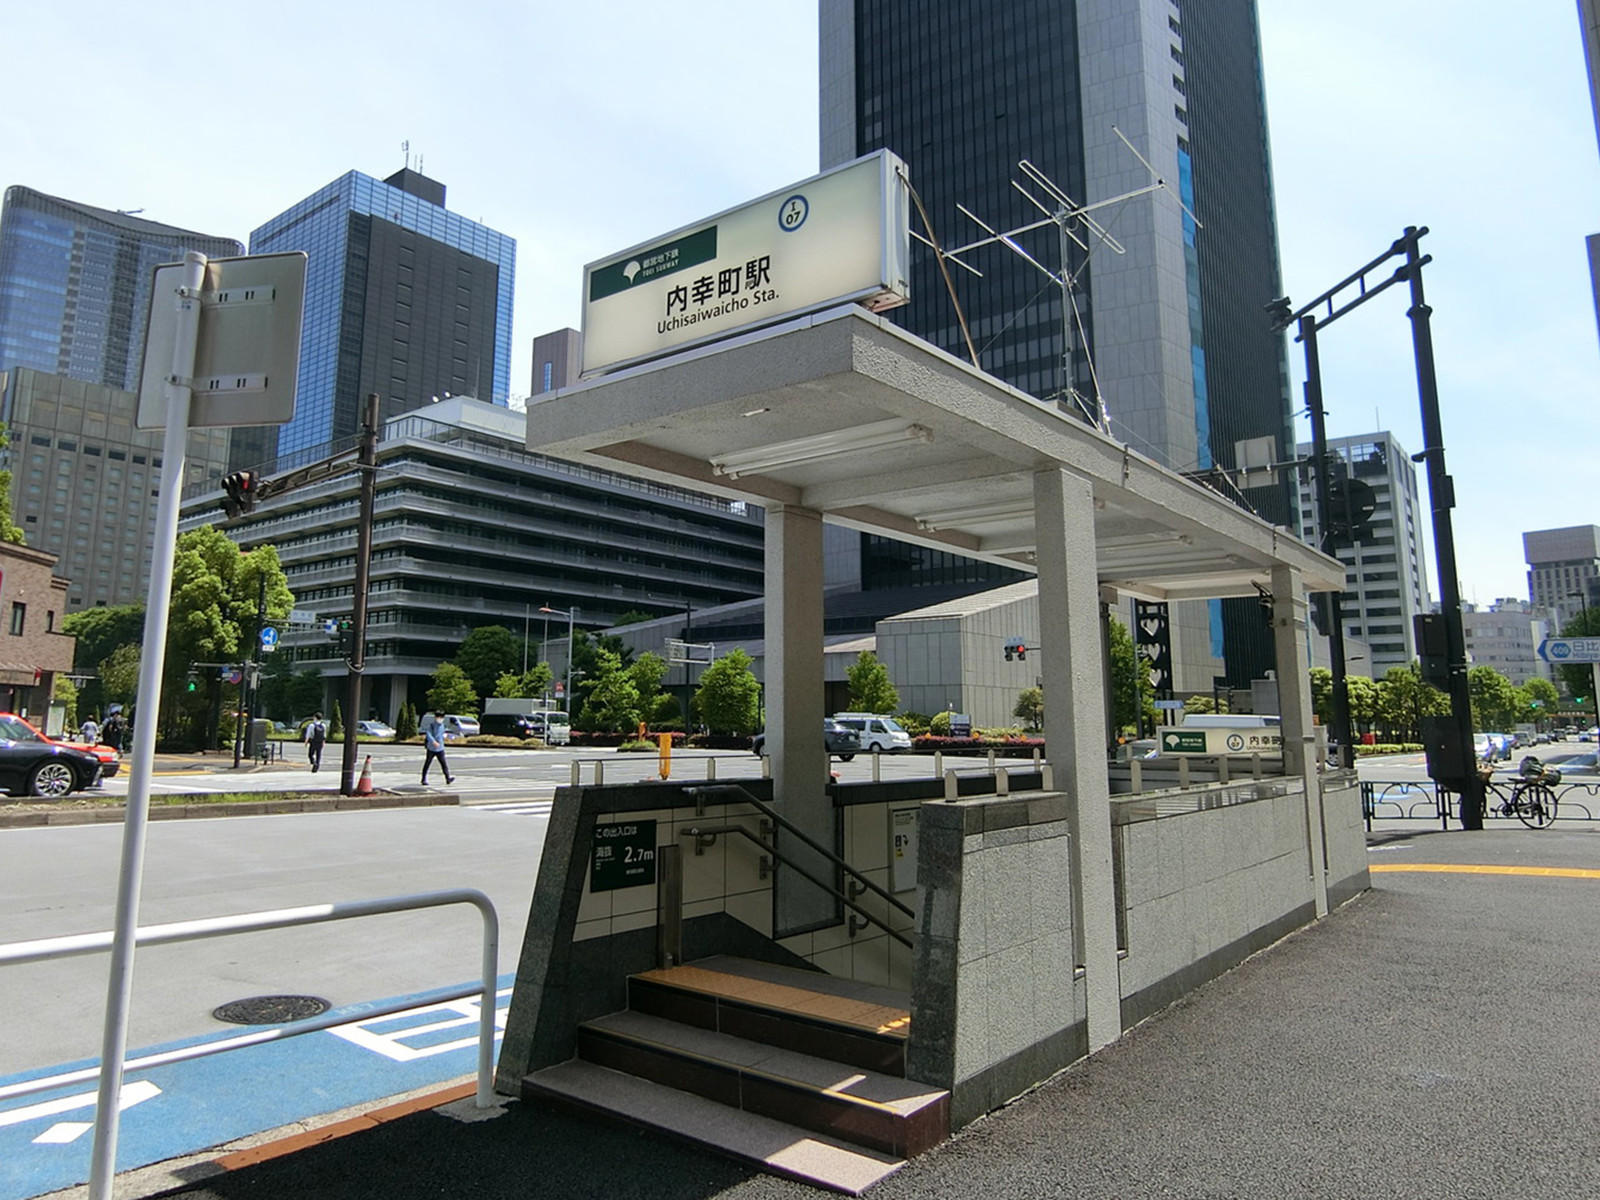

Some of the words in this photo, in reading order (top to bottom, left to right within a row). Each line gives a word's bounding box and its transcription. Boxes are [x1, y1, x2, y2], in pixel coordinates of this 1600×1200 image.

[785, 211, 801, 225] 07
[666, 255, 771, 317] 内幸町駅
[657, 297, 749, 334] Uchisaiwaicho
[753, 289, 779, 305] Sta.
[595, 826, 638, 839] この出入口は
[624, 846, 654, 863] 2.7m
